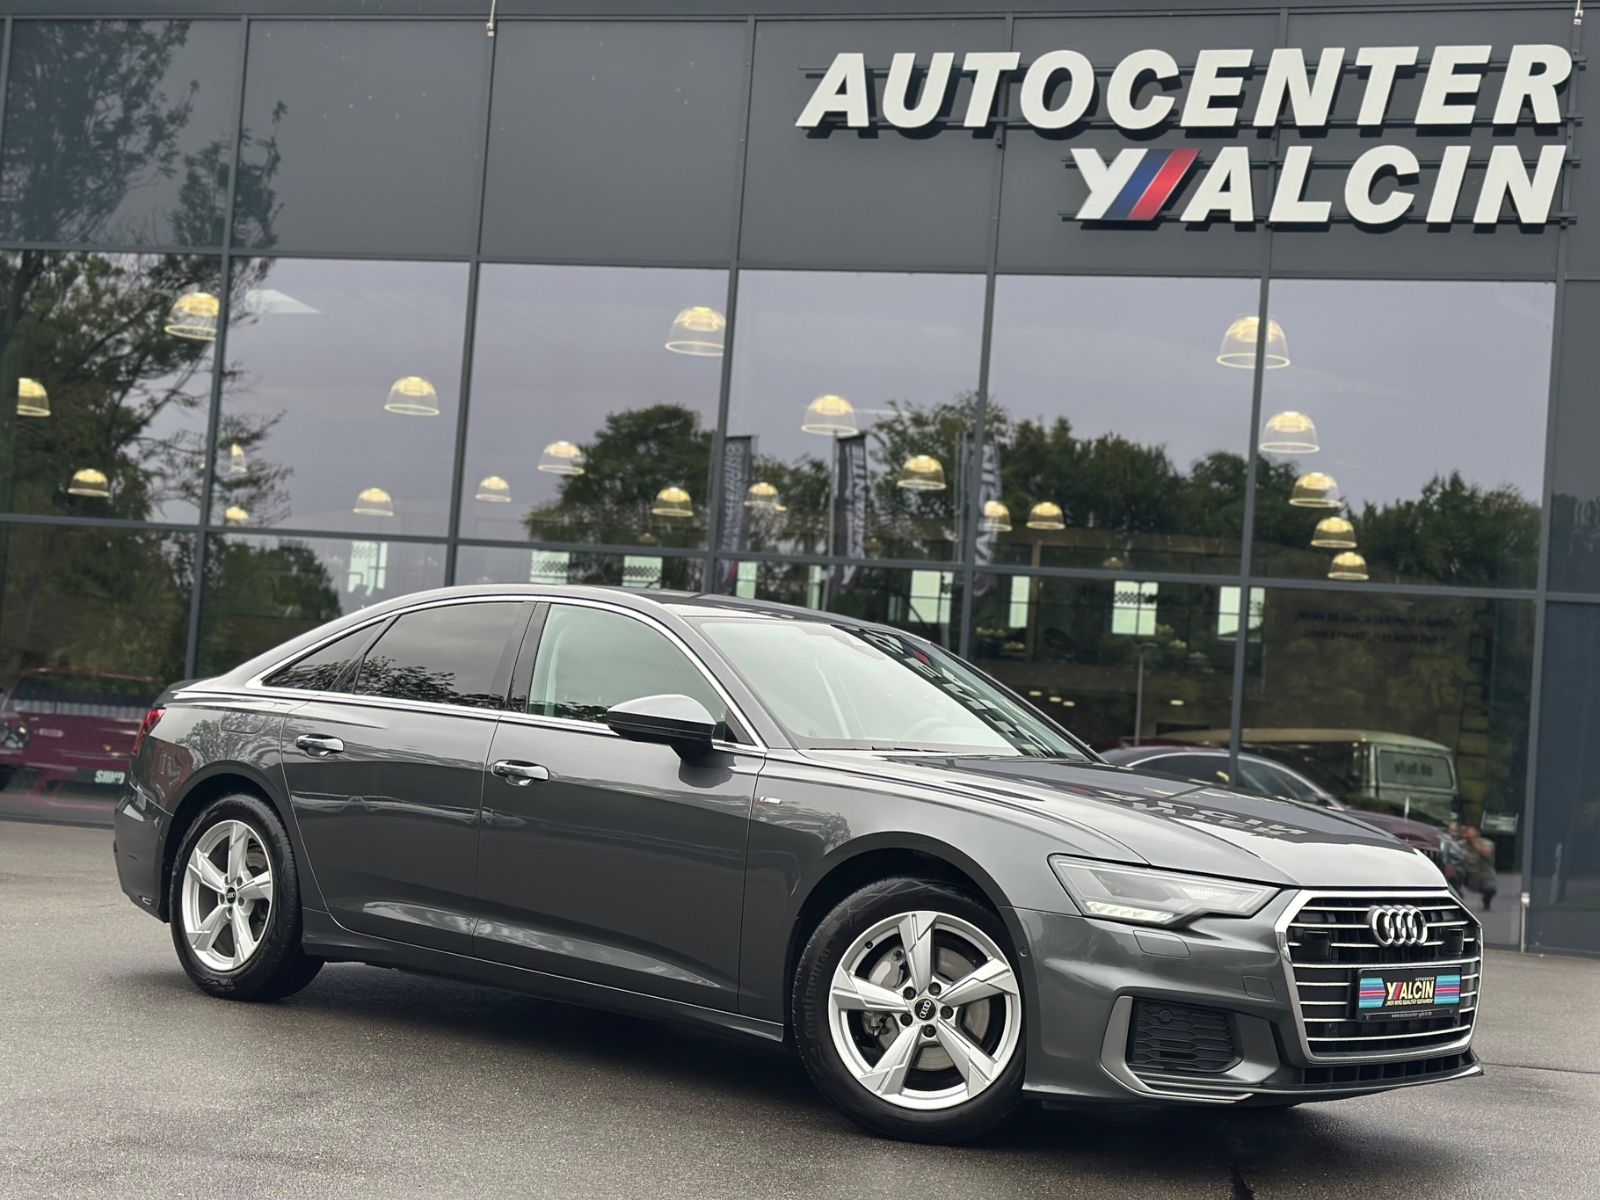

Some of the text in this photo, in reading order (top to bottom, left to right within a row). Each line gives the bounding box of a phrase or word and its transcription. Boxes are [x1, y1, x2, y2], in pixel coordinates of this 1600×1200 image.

[795, 44, 1572, 131] AUTOCENTER
[1070, 144, 1566, 225] YALCIN
[1386, 981, 1434, 1000] YALCIN
